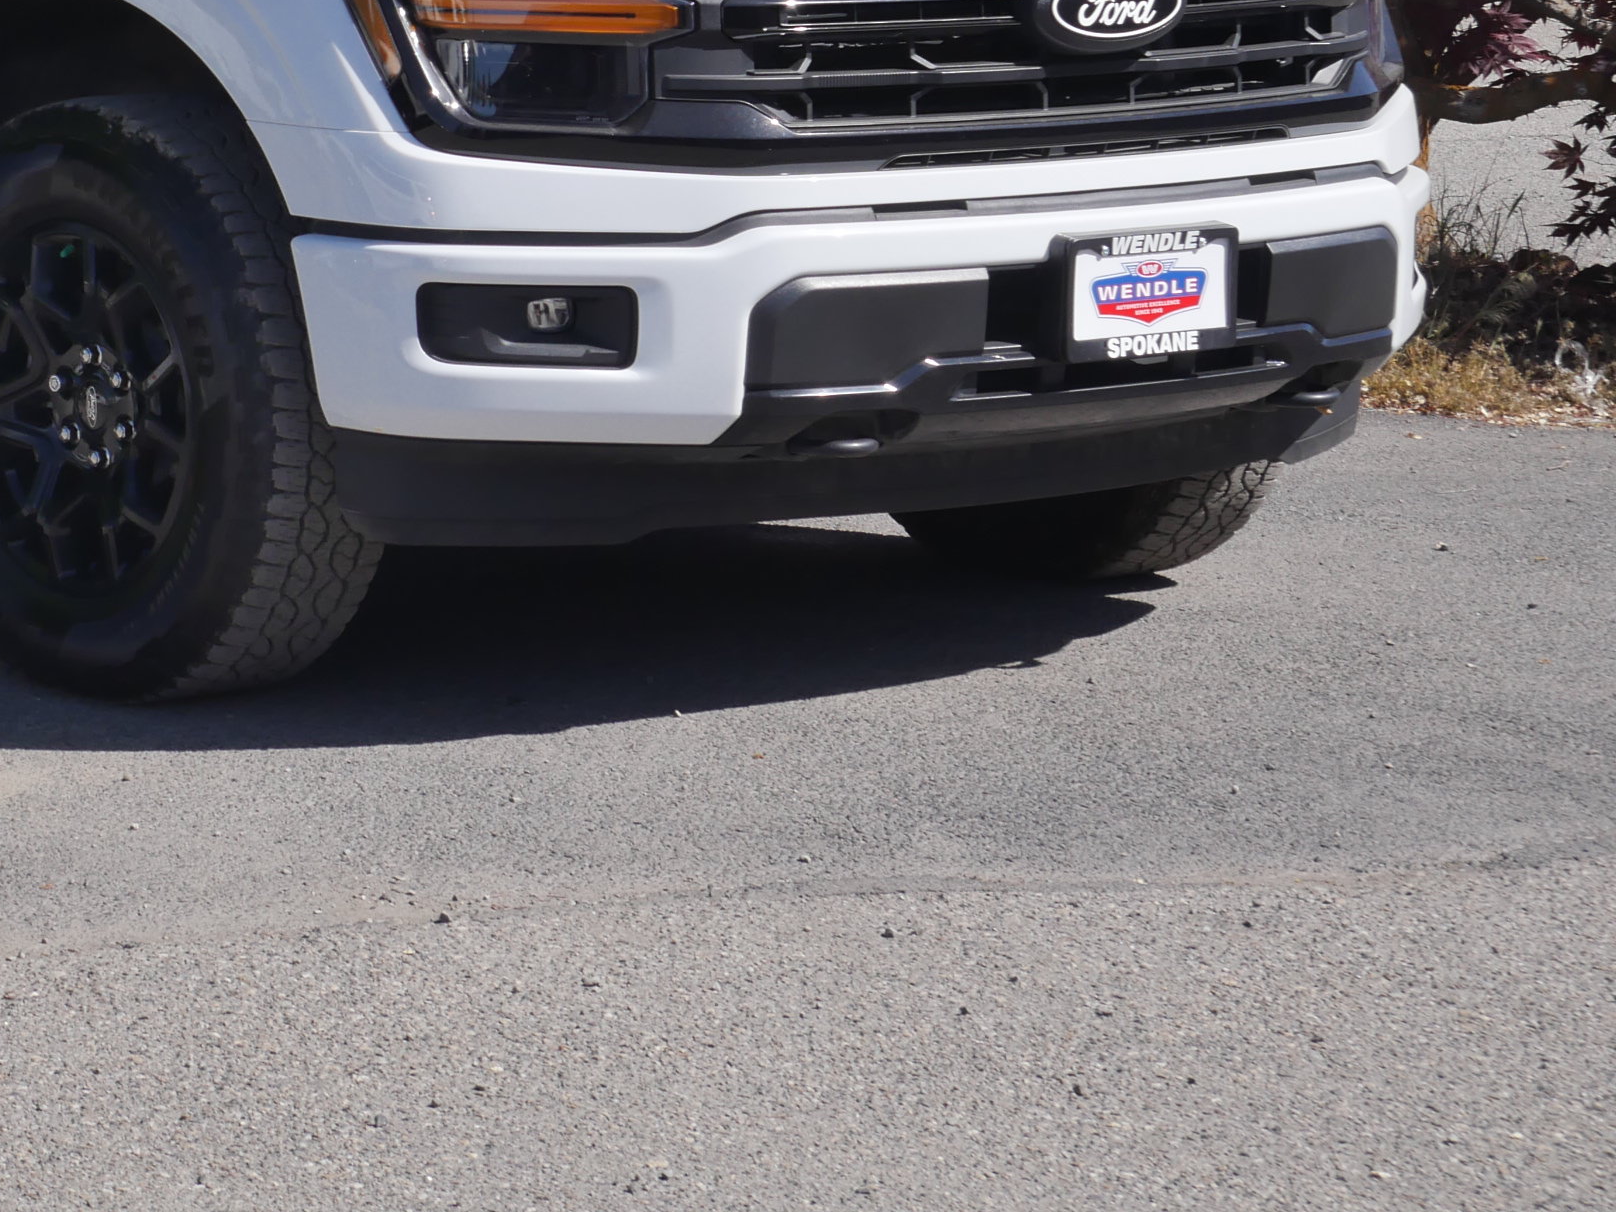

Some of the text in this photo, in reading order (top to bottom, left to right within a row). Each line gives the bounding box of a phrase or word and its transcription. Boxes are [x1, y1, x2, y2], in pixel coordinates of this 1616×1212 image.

[1111, 230, 1200, 255] WENDLE
[1097, 277, 1198, 301] WENDLE
[1106, 330, 1200, 360] SPOKANE
